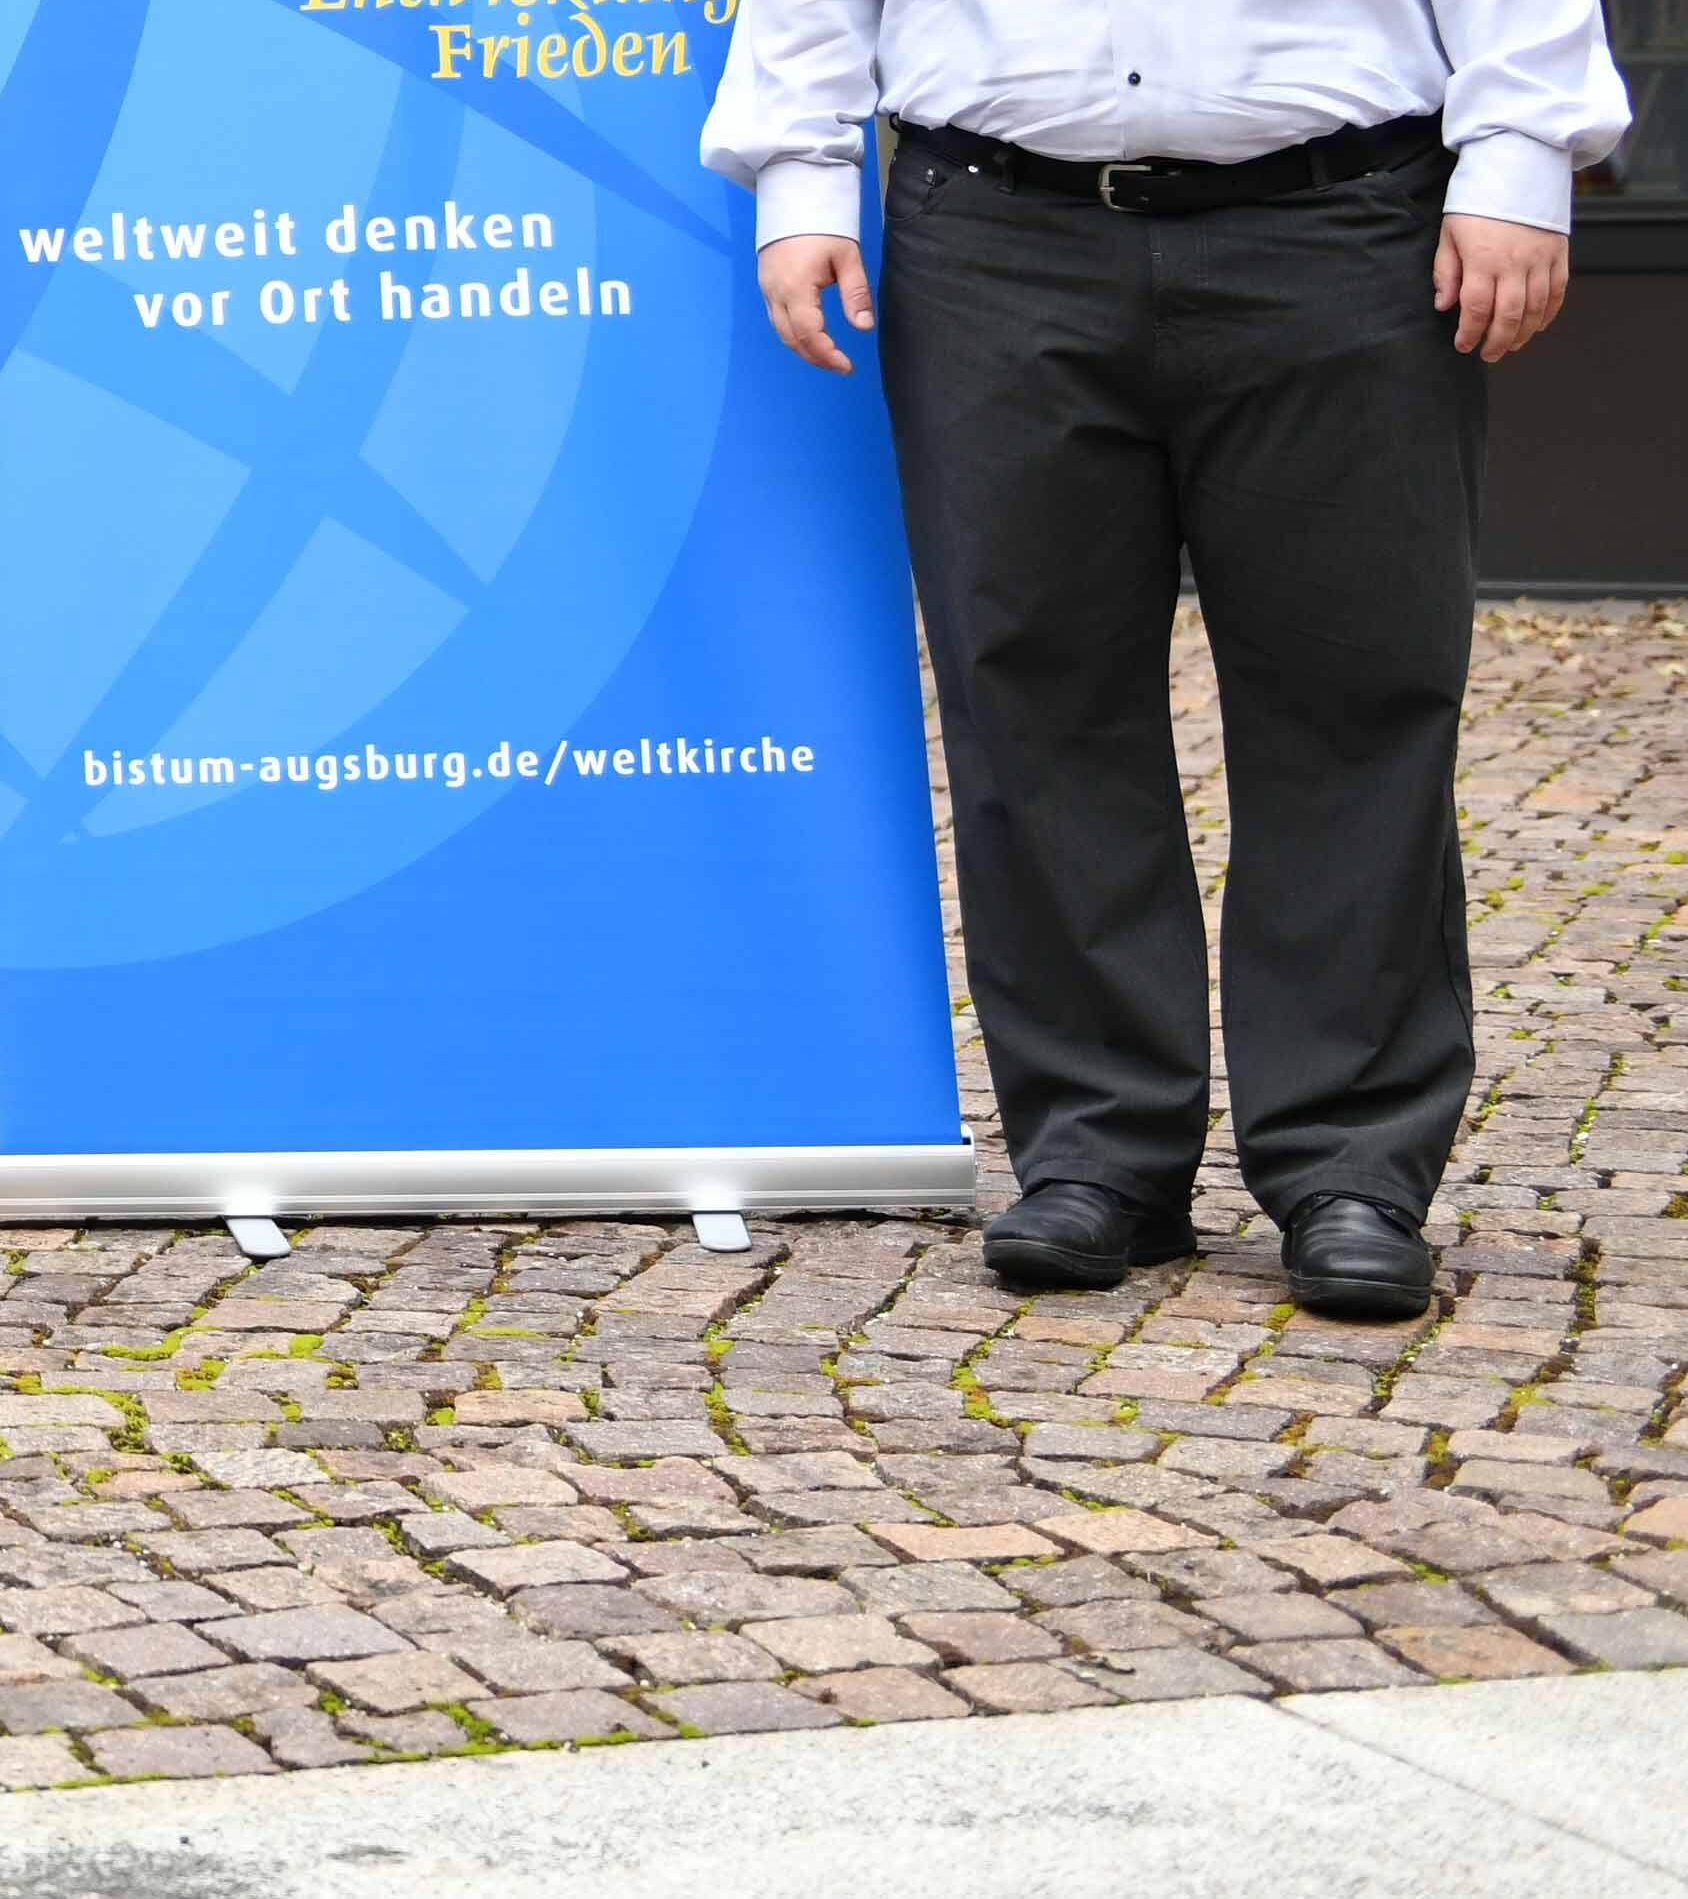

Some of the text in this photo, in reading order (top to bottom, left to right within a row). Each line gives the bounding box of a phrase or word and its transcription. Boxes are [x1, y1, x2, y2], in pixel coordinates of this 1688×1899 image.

[429, 15, 692, 79] Frieden
[20, 201, 554, 264] weltweit denken
[134, 265, 634, 328] vor Ort handeln
[82, 735, 816, 792] bistum-augsburg.de/weltkirche
